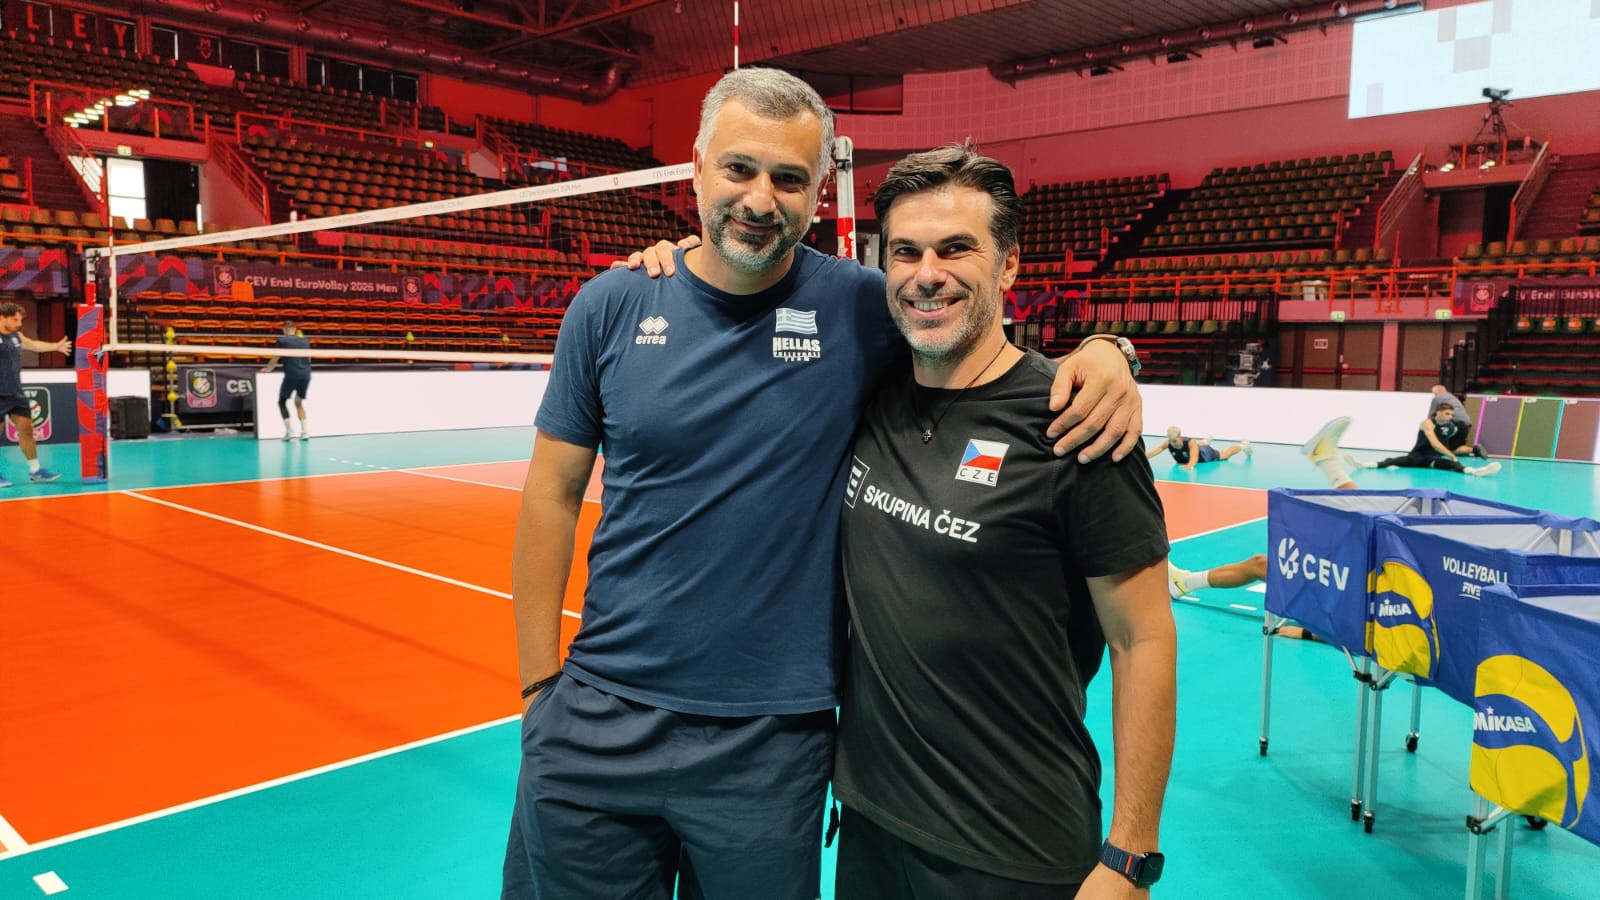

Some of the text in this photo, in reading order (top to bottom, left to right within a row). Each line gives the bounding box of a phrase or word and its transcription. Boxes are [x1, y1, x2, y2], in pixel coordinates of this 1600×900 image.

[244, 275, 398, 293] CEV Enel EuroVolley 2026 Men
[772, 336, 821, 352] HELLAS
[959, 467, 996, 482] CZE
[863, 485, 981, 543] SKUPINA ČEZ
[1302, 553, 1350, 592] CEV
[1442, 556, 1508, 585] VOLLEYBALL
